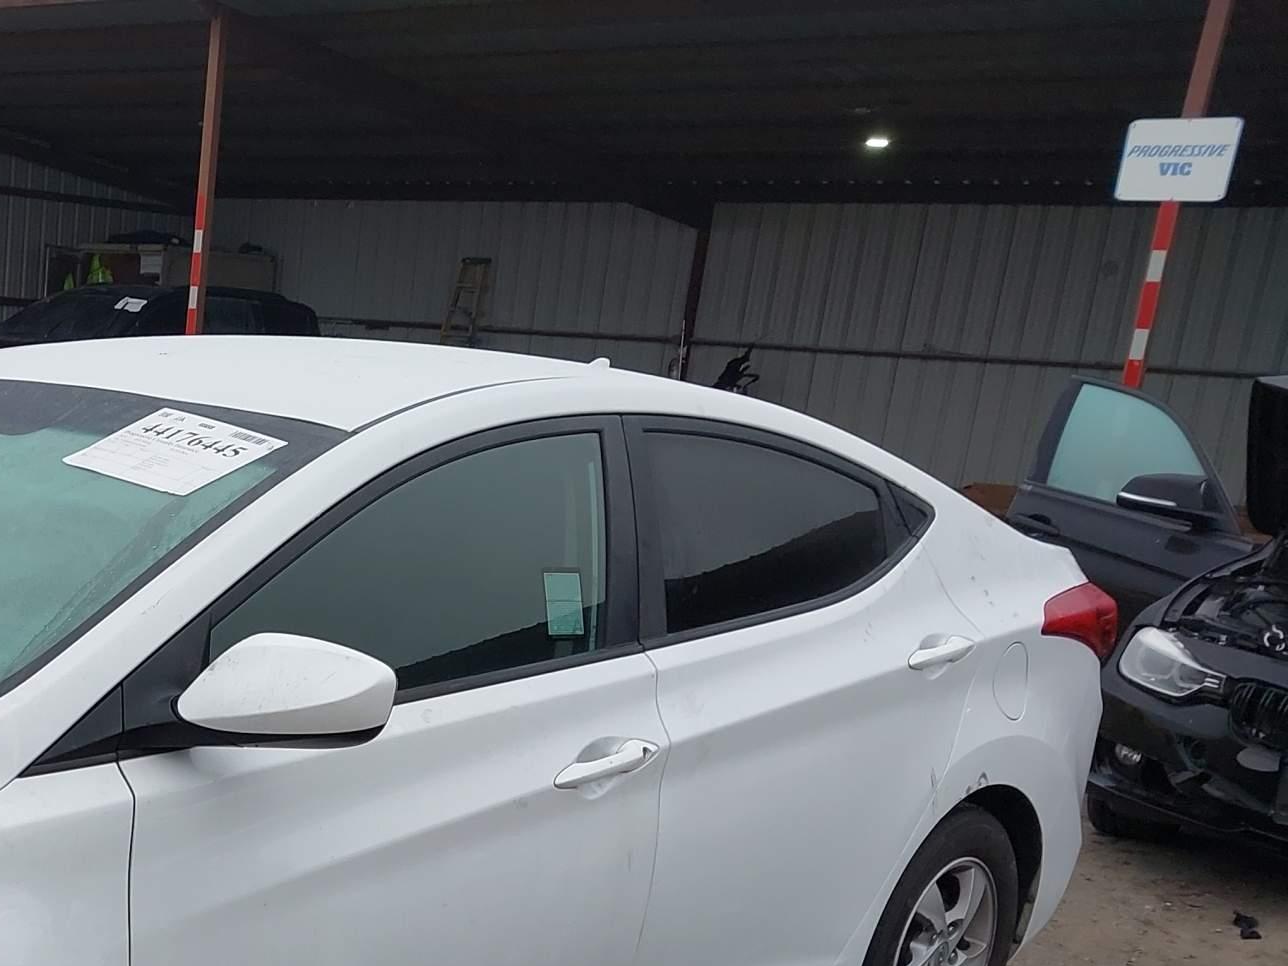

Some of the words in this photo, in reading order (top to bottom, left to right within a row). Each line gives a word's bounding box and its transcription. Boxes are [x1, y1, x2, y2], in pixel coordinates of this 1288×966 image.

[1127, 144, 1229, 158] PROGRESSIVE
[1159, 162, 1192, 177] VIC
[142, 423, 248, 458] 44176445
